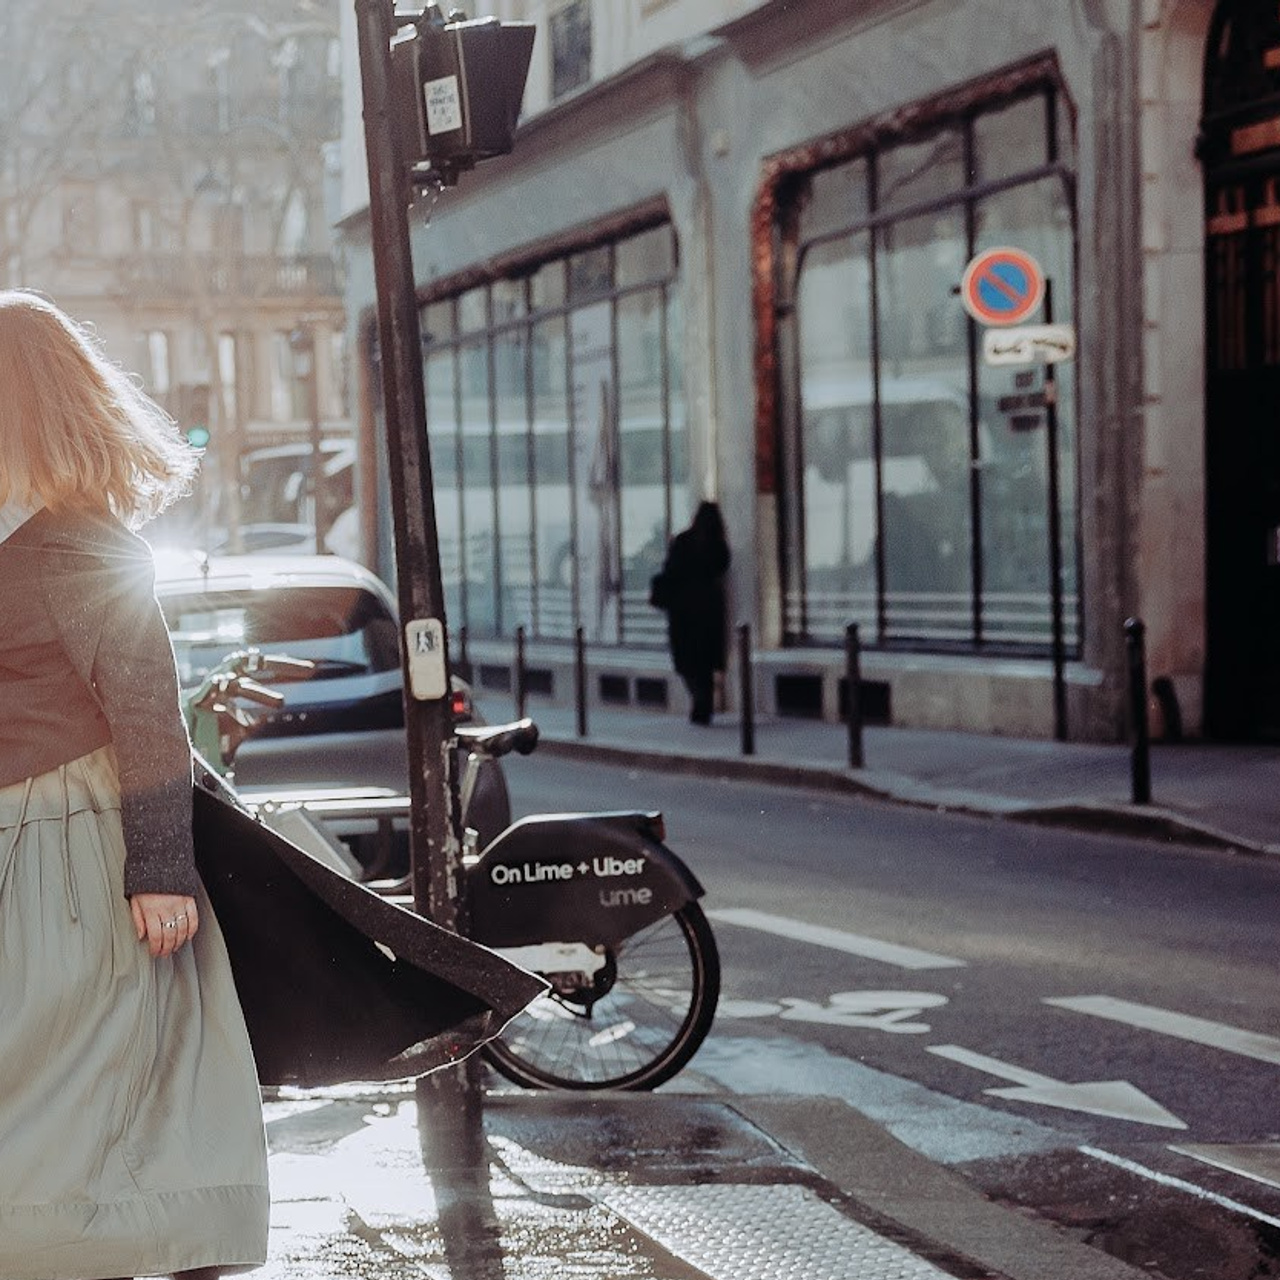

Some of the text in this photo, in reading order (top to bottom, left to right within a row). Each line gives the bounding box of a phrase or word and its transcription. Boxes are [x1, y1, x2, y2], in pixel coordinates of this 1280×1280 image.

[491, 856, 645, 884] On Lime + Uber
